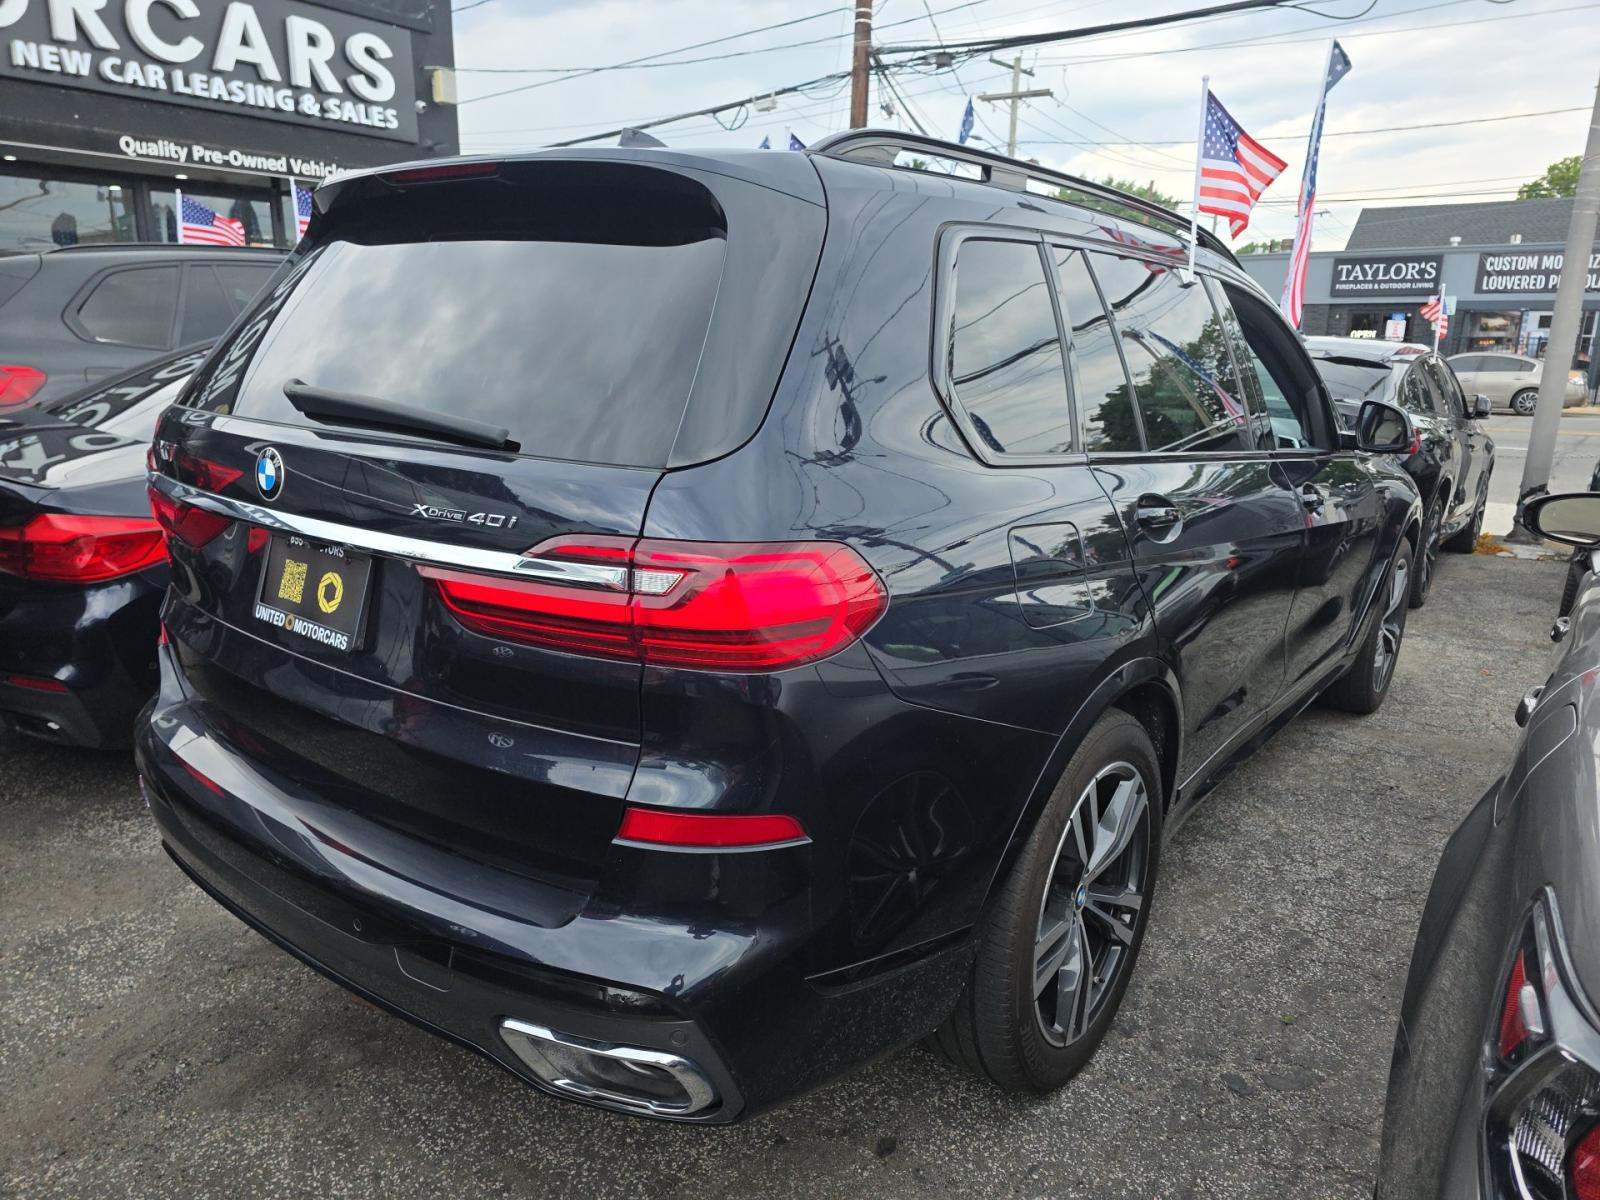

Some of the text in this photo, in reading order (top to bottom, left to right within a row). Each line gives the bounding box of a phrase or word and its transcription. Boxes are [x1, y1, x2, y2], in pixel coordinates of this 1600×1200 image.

[0, 0, 397, 102] RCARS
[10, 39, 399, 129] NEW CAR LEASING & SALES
[118, 135, 188, 163] Quality
[192, 144, 287, 173] Pre-Owned
[1337, 261, 1438, 281] TAYLOR'S
[1485, 255, 1539, 271] CUSTOM
[1335, 282, 1373, 291] FIREPLACES
[1380, 281, 1412, 290] OUTDOOR
[1412, 281, 1434, 289] LIVING
[1482, 274, 1546, 290] LOUVERED
[255, 604, 348, 650] UNITED MOTORCARS
